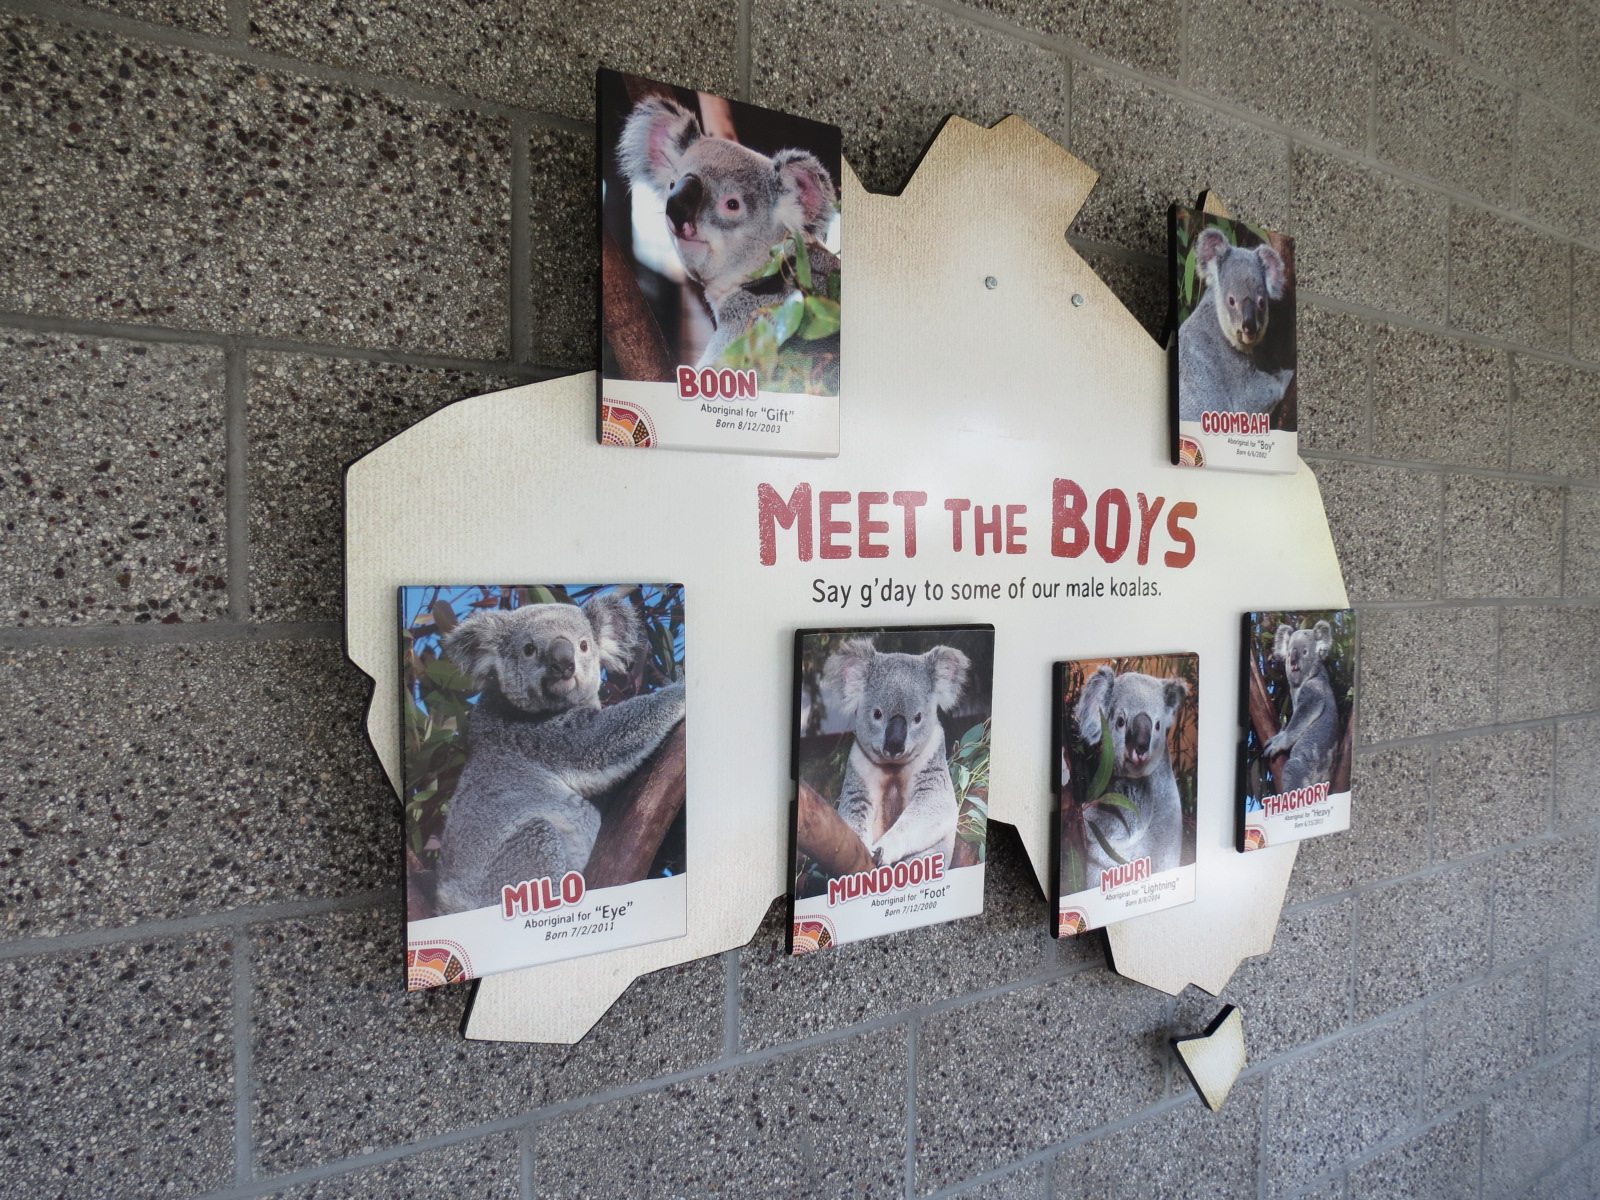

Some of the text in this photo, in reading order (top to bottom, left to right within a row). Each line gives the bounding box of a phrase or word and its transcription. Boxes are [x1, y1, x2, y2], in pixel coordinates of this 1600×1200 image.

[678, 366, 757, 399] BOON
[700, 403, 794, 423] Aboriginal for "Gift"
[1202, 411, 1269, 434] COOMBAH
[715, 418, 781, 434] Born 8/12/2003
[1227, 437, 1249, 448] Aboriginal
[1257, 440, 1275, 452] "Boy"
[757, 477, 1198, 569] MEET THE BOYS
[811, 575, 1162, 608] Say g'day to some of our male koalas.
[1262, 783, 1330, 818] THACKORY
[829, 853, 943, 906] MUNDOOIE
[1101, 856, 1150, 893] MUURI
[504, 872, 584, 918] MILO
[870, 884, 951, 908] Aboriginal for "Foot"
[1105, 877, 1180, 902] Aboriginal for "Lightning"
[524, 901, 633, 929] Aboriginal for "Eye"
[884, 901, 937, 917] Born 7/12/2000
[1125, 899, 1137, 908] Born
[545, 921, 615, 941] Born 7/2/2011
